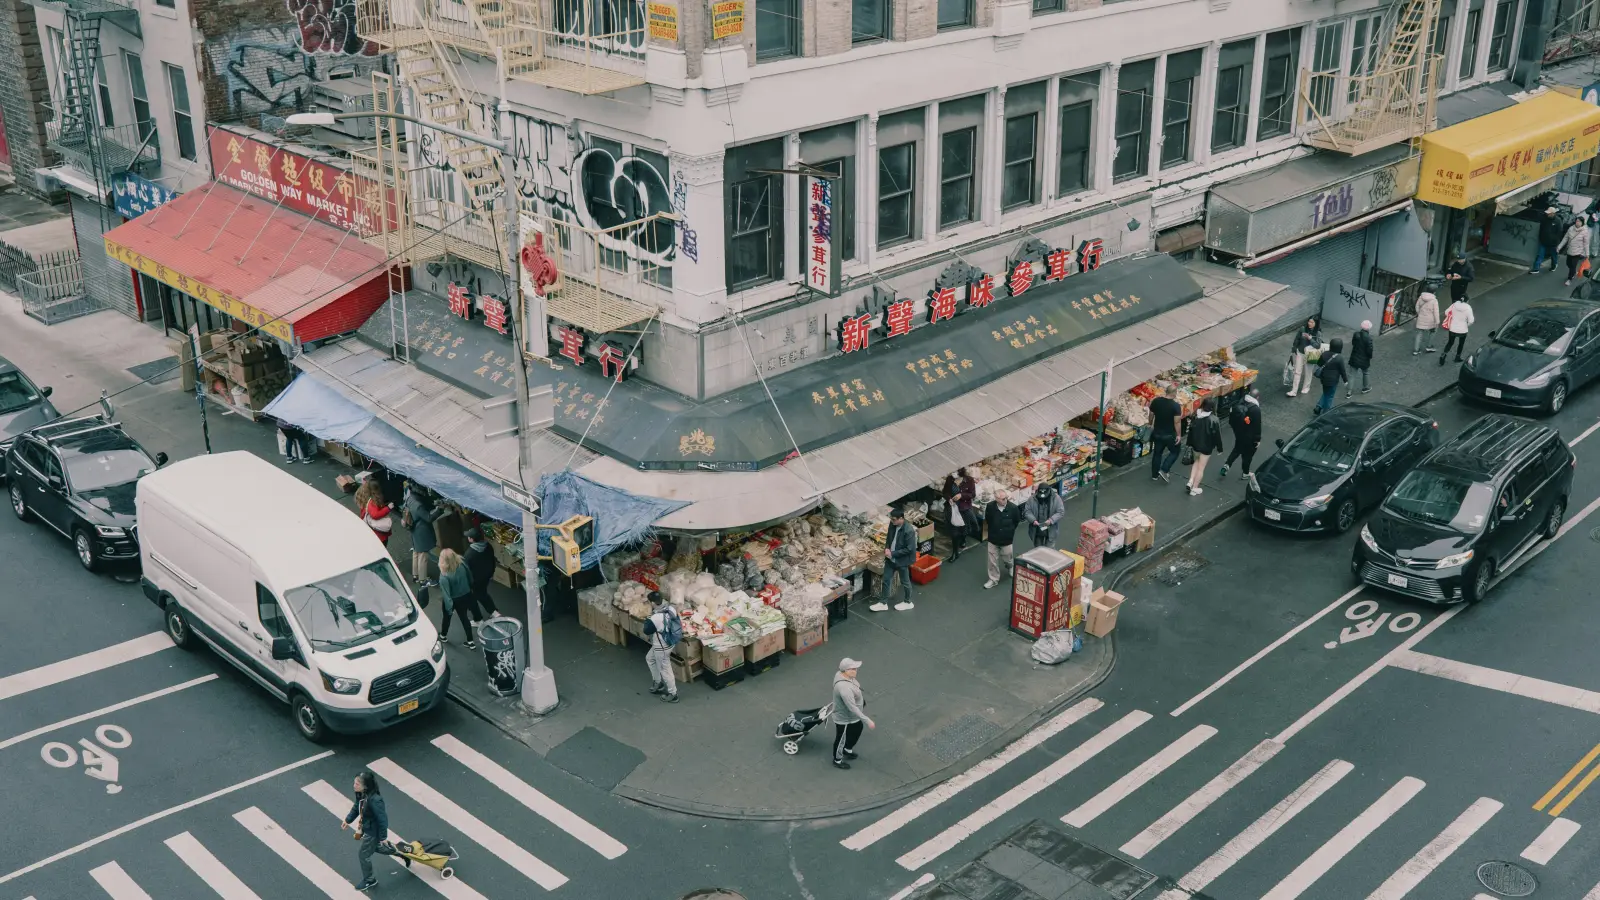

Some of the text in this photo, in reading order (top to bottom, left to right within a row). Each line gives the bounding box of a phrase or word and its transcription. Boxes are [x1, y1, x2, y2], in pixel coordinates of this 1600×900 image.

[229, 177, 264, 196] MARKET
[240, 168, 277, 192] GOLDEN
[280, 183, 302, 201] WAY
[307, 193, 348, 218] MARKET
[841, 239, 1104, 354] 新聲海味參茸行
[506, 488, 536, 509] ONE WAY
[1015, 602, 1033, 618] LOVE
